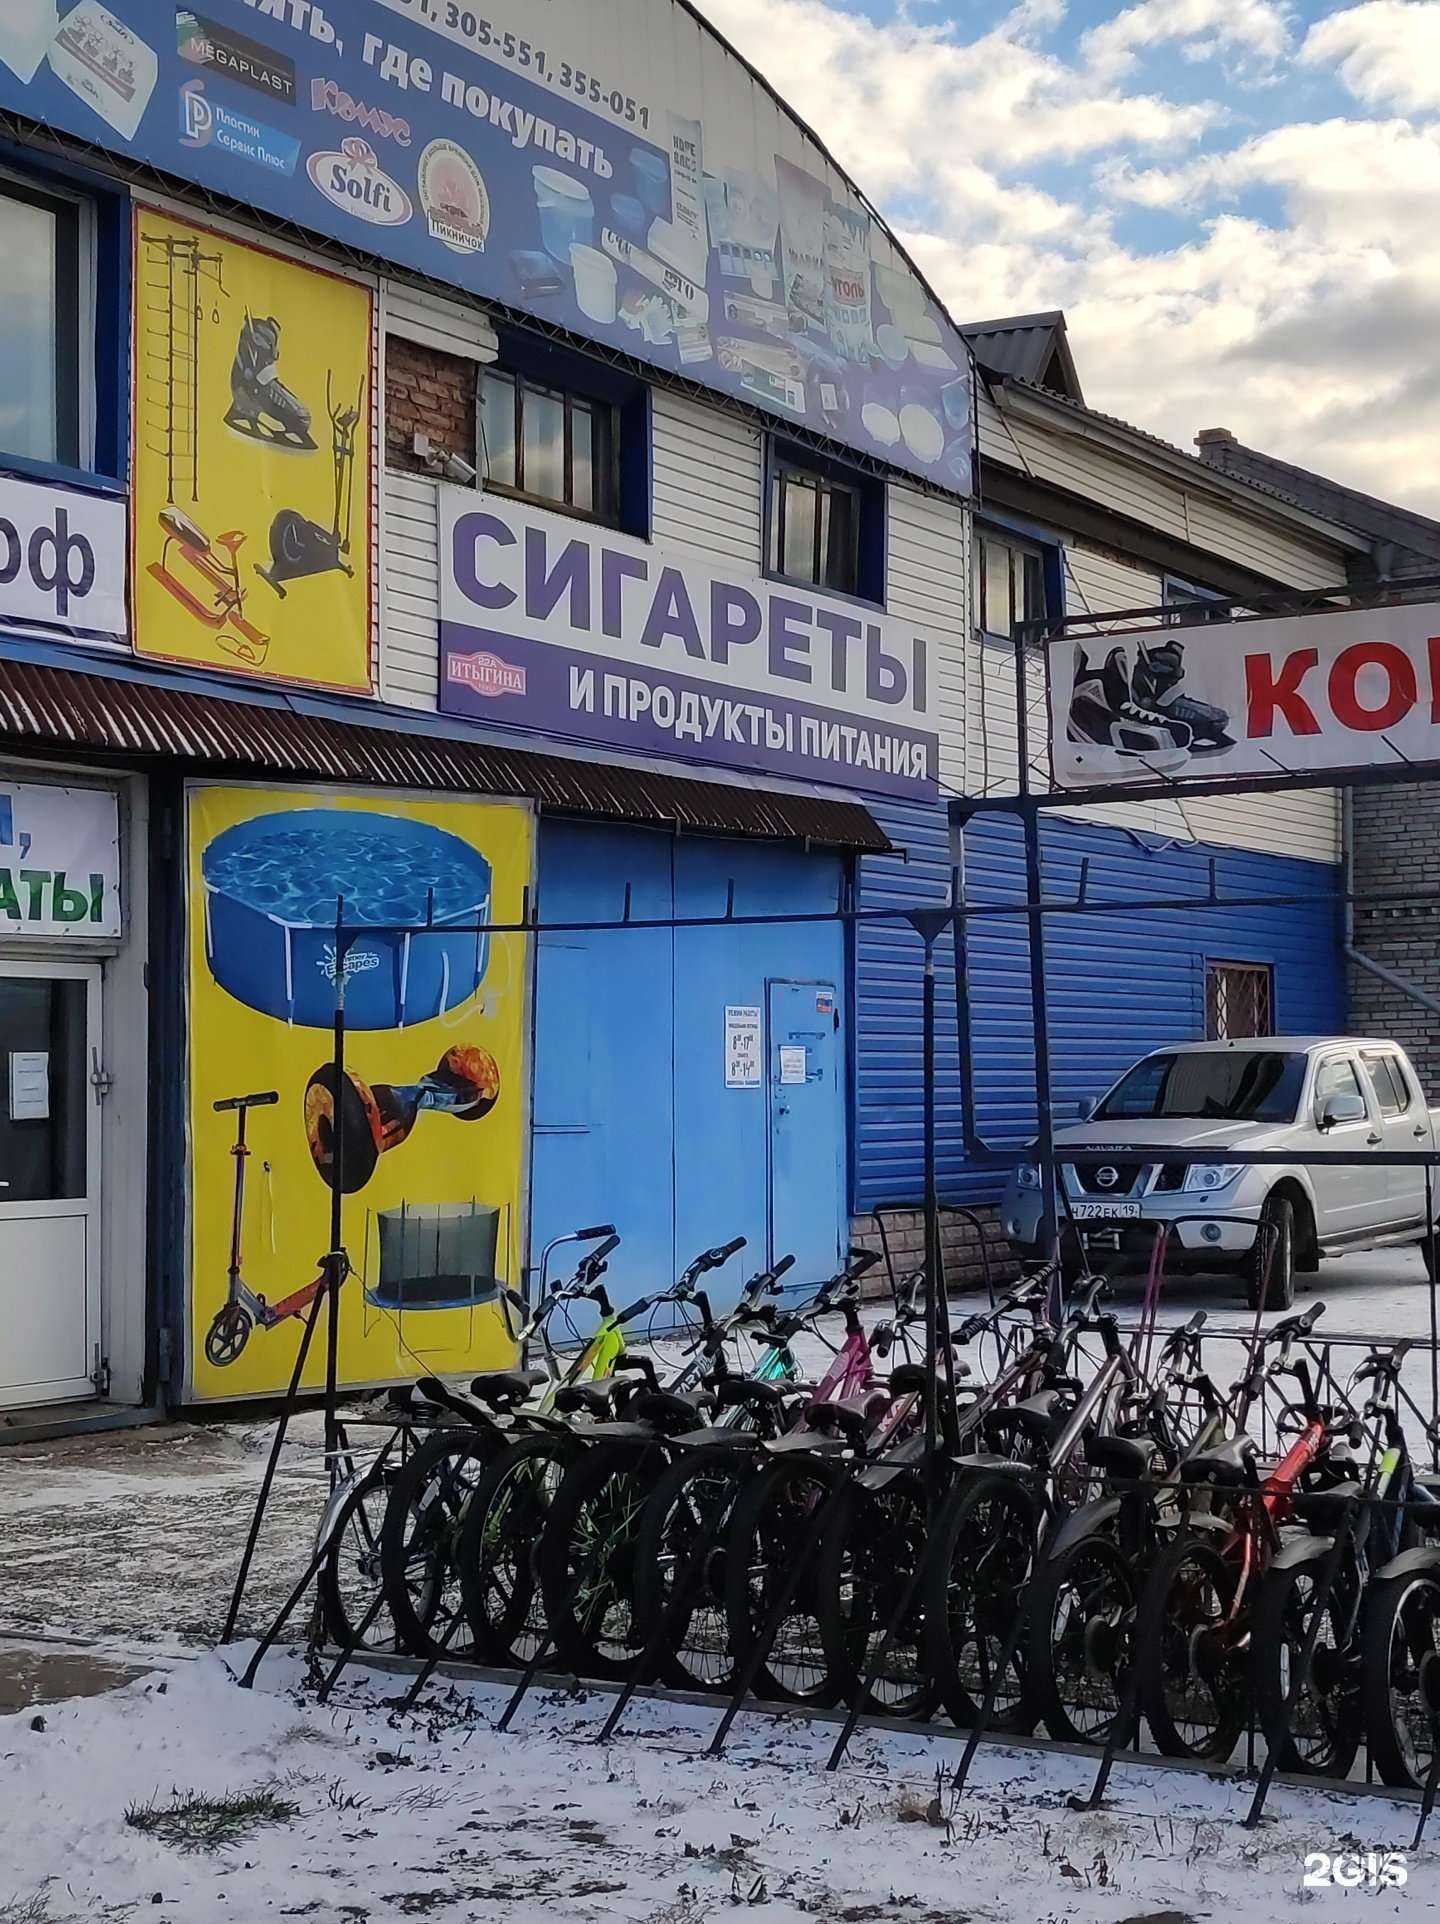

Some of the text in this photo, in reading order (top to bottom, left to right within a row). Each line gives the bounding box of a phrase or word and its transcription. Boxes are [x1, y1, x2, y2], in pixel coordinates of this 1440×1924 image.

[190, 37, 293, 95] MEGAPLAST
[445, 2, 552, 82] 305-551,
[559, 62, 649, 130] 355-051
[215, 105, 261, 139] Пластик
[362, 32, 433, 92] где
[441, 71, 613, 180] покупать
[330, 163, 392, 213] Solfi
[431, 218, 484, 249] Пикничок
[452, 511, 927, 714] СИГАРЕТЫ
[450, 659, 522, 689] ИТЫГИНА
[1244, 637, 1440, 739] КО
[569, 666, 928, 781] И ПРОДУКТЫ ПИТАНИЯ
[1123, 1205, 1134, 1215] 19
